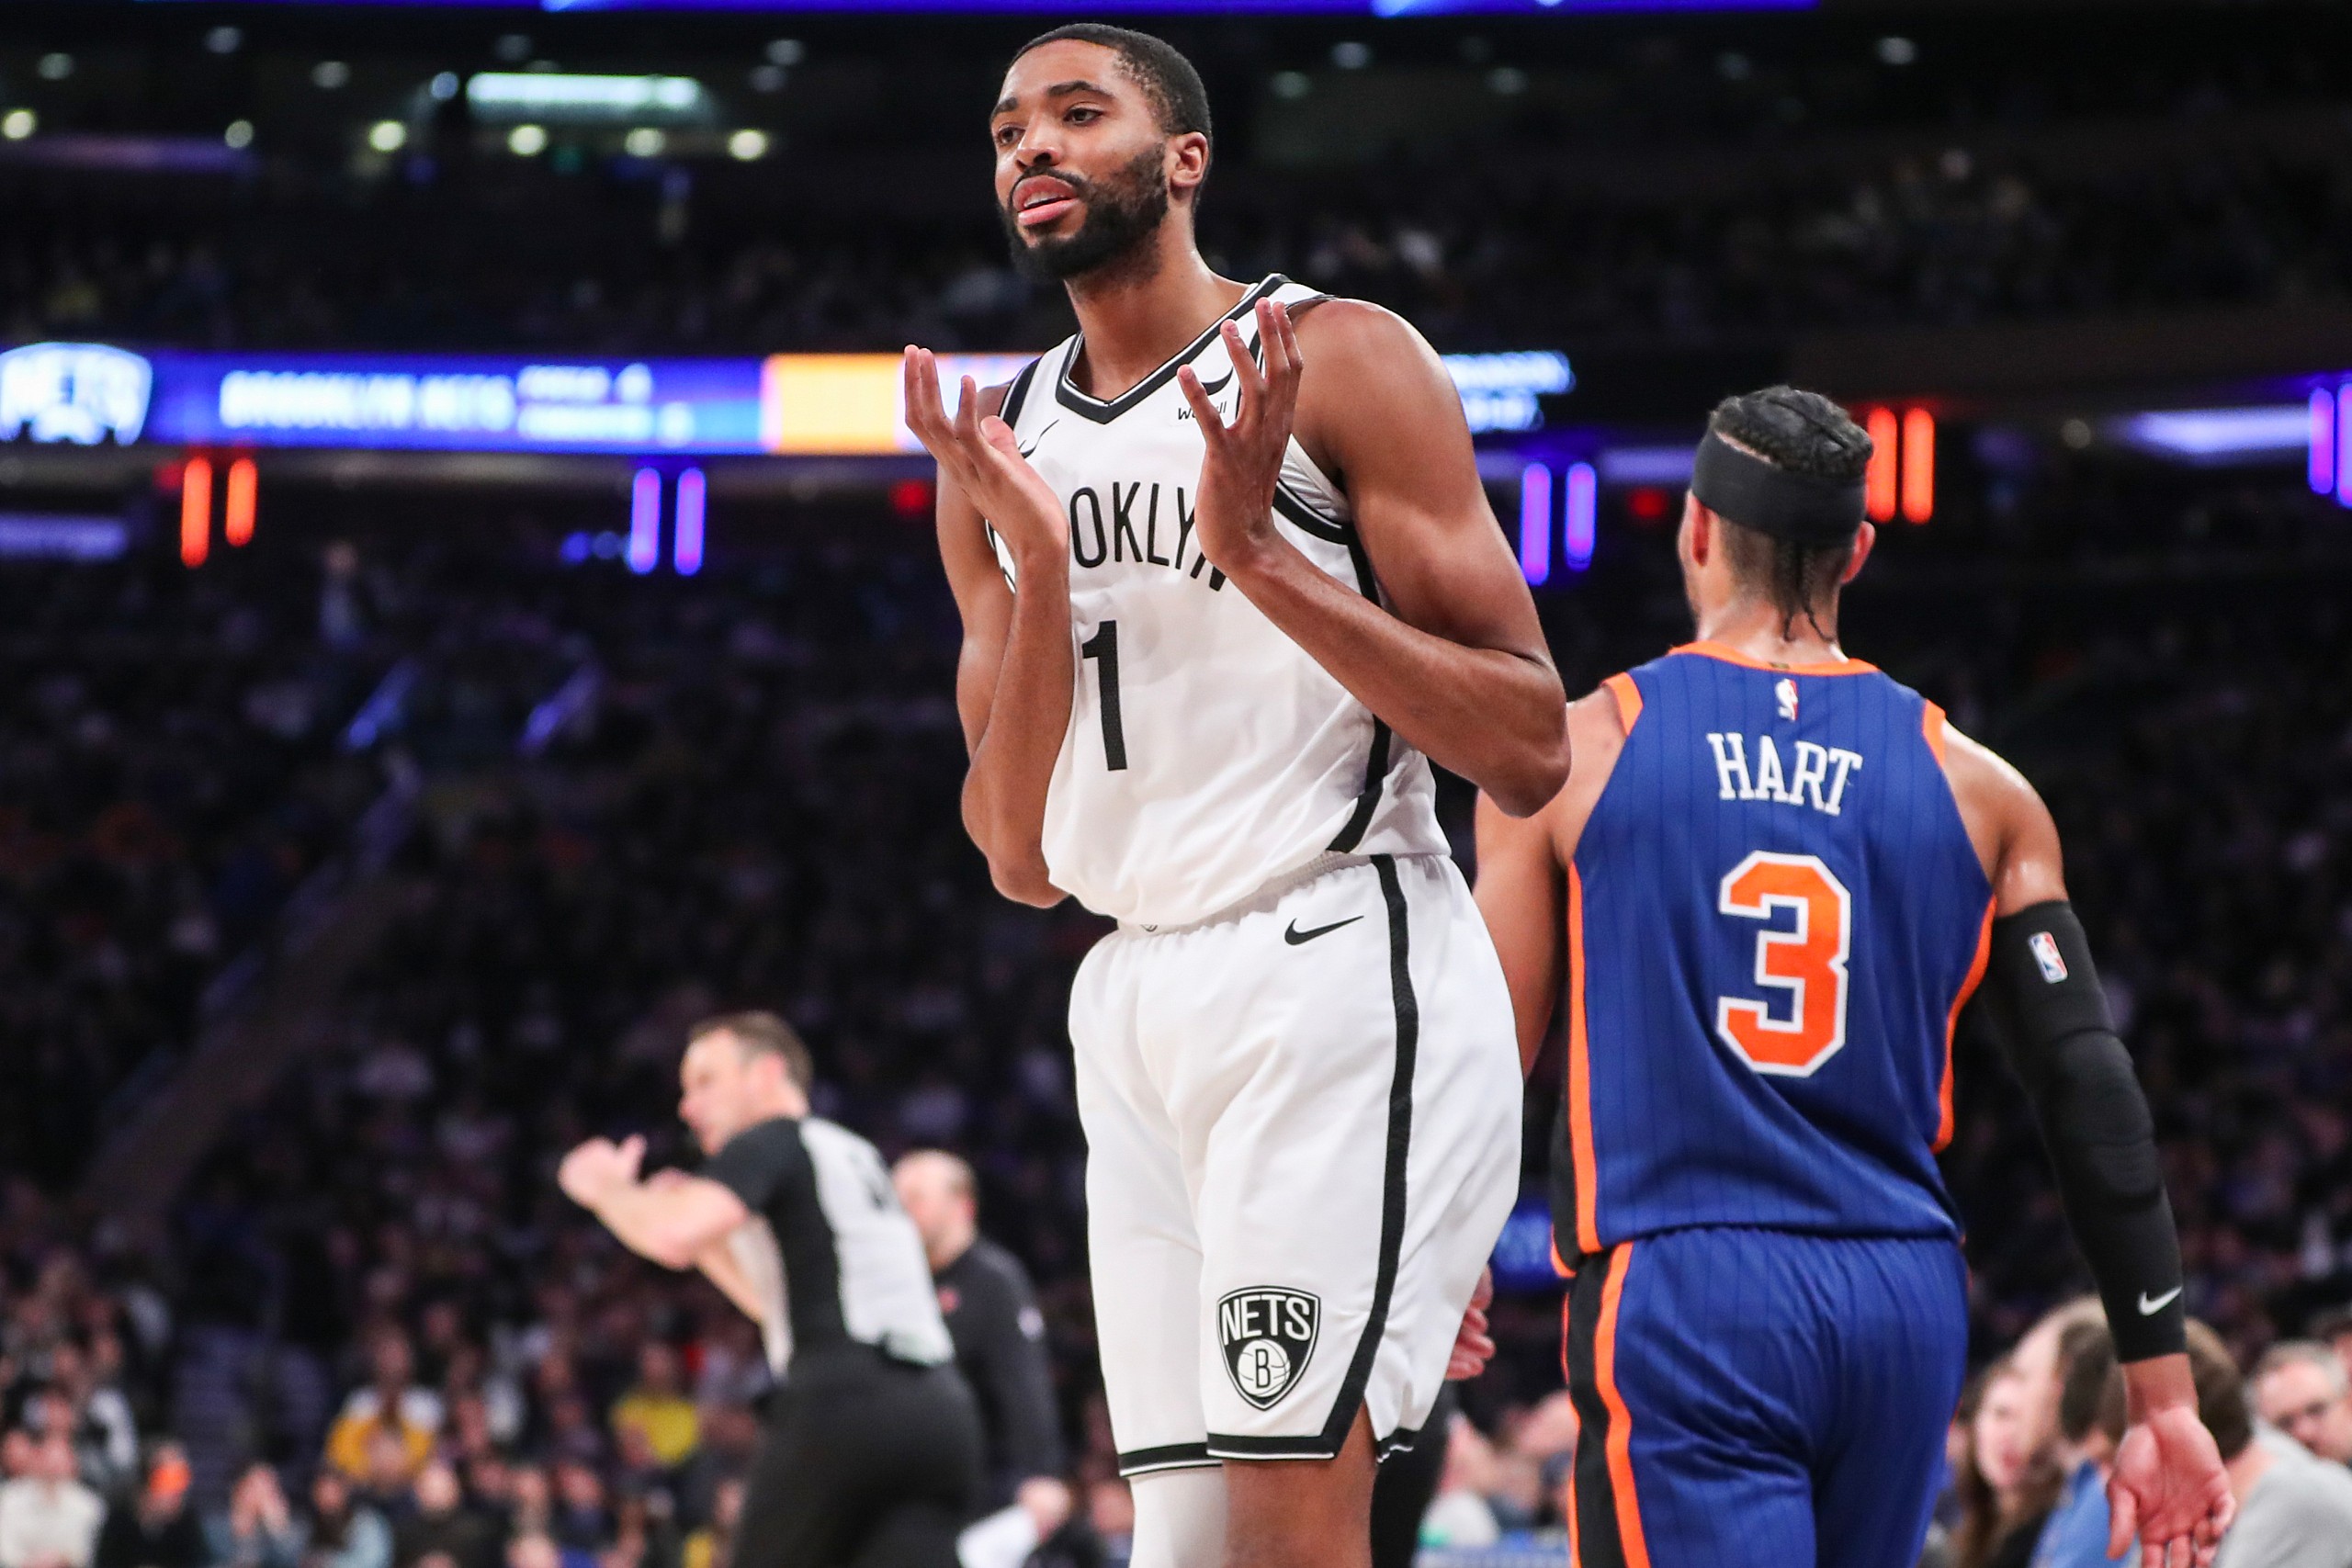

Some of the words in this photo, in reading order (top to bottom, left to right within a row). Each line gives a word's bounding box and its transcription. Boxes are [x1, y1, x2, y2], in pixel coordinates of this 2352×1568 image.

[1081, 620, 1128, 772] 1
[1706, 732, 1863, 817] HART
[1716, 850, 1851, 1077] 3
[1221, 1293, 1312, 1346] NETS
[1255, 1348, 1272, 1389] B
